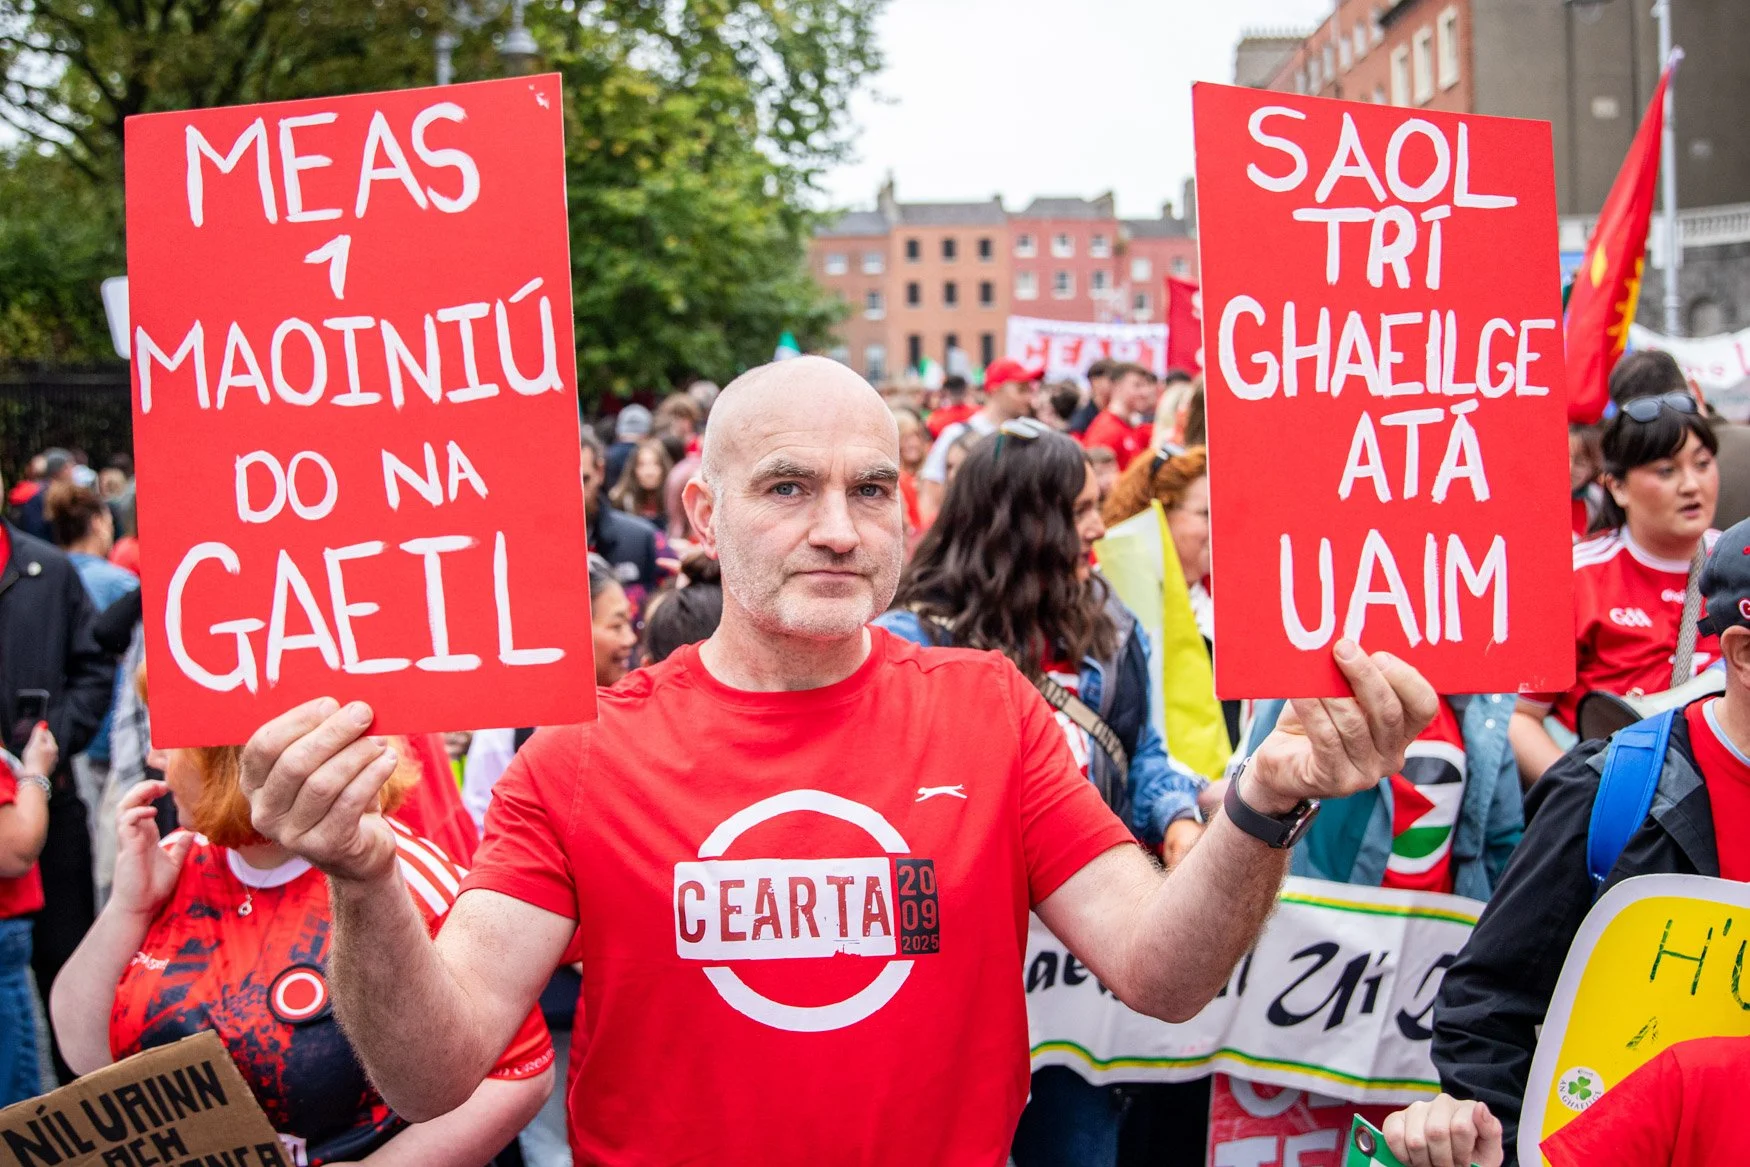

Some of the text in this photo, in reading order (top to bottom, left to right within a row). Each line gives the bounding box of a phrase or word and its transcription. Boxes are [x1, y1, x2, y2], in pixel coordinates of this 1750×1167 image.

[186, 102, 480, 227] MEAS
[1246, 106, 1518, 209] SAOL
[1292, 205, 1451, 290] TRÍ
[126, 277, 563, 414] MAOINIÚ
[1218, 295, 1556, 400] GHAEILGE
[235, 441, 489, 523] DO NA
[1337, 399, 1490, 504] ATÁ
[165, 531, 567, 694] GAEIL
[1279, 529, 1508, 650] UAIM
[677, 876, 892, 943] CEARTA
[898, 865, 936, 896] 20
[902, 899, 938, 931] 09
[902, 934, 940, 951] 2025
[0, 1060, 229, 1167] NÍL UAINN
